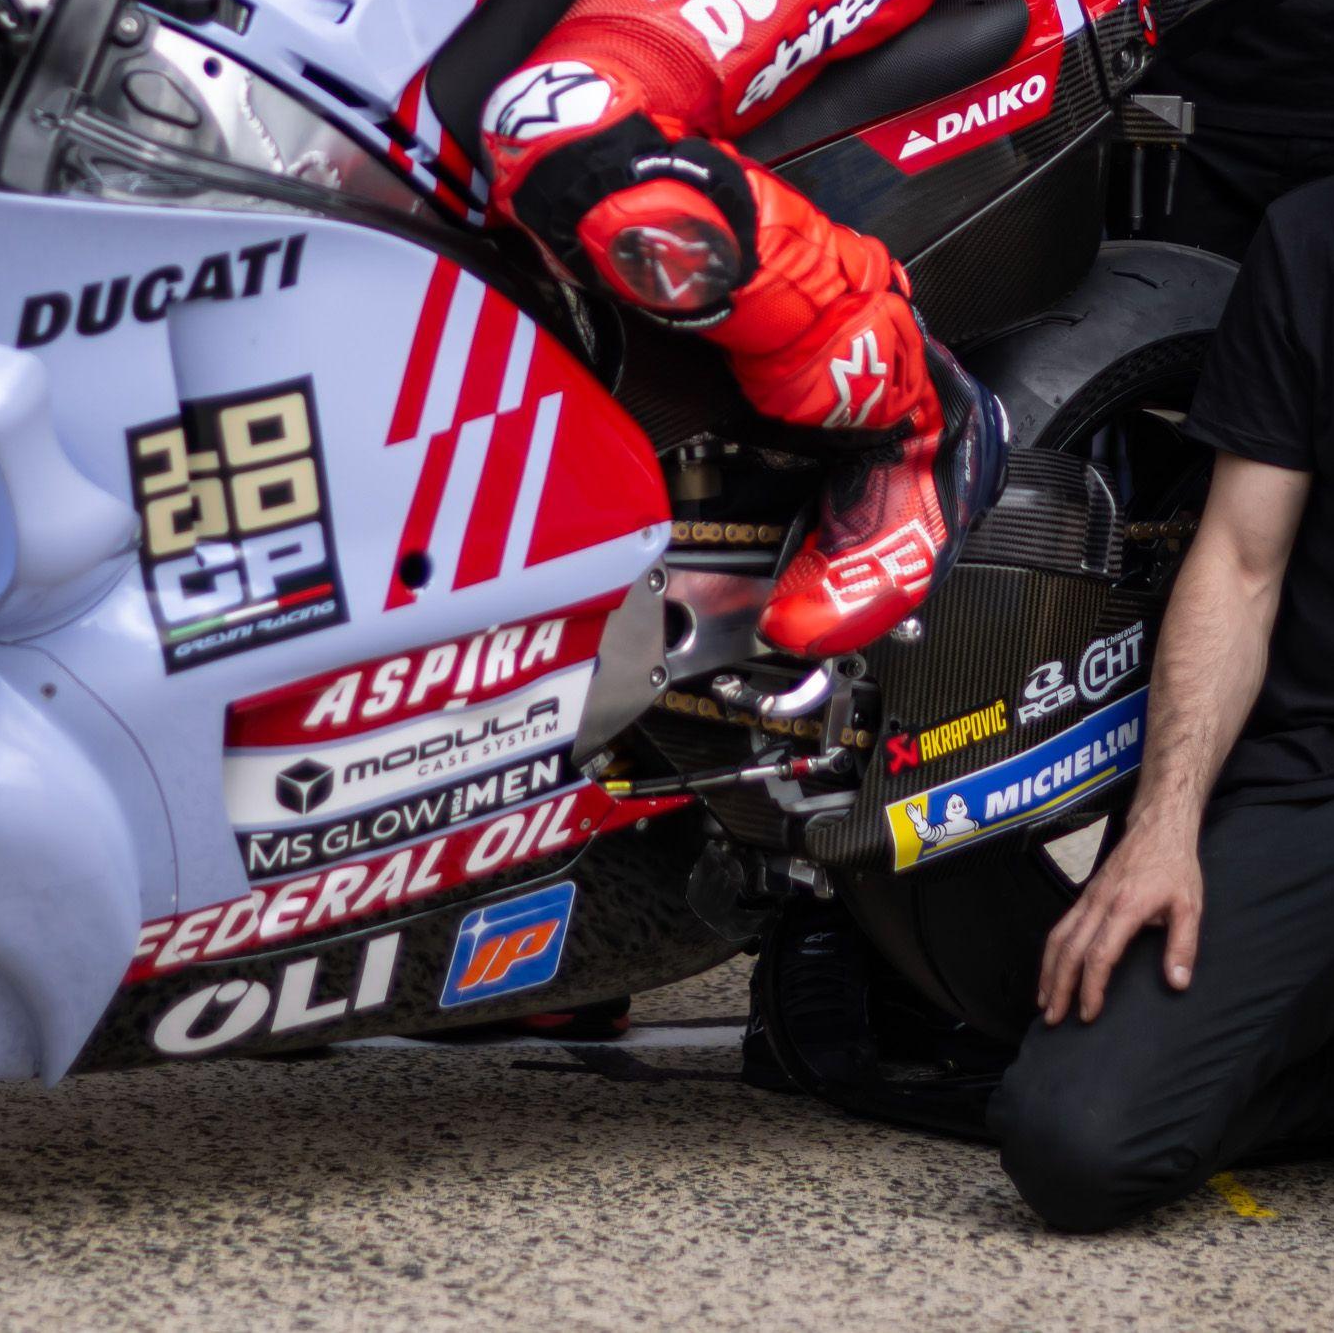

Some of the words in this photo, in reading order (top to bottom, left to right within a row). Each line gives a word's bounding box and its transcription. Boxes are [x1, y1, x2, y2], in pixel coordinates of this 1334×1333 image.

[936, 74, 1047, 143] DAIKO
[15, 232, 308, 349] DUCATI
[153, 521, 327, 624] GP
[173, 624, 254, 658] GRESINI
[255, 598, 337, 631] RACING
[1088, 630, 1144, 687] CHT
[1105, 619, 1143, 647] Chiaravalli
[301, 617, 567, 729] ASPIRA
[1017, 684, 1077, 725] RCB
[343, 695, 560, 784] MODULA
[417, 752, 470, 777] CASE
[482, 720, 559, 757] SYSTEM
[920, 699, 1007, 762] AKRAPOVIČ
[984, 717, 1139, 820] MICHELIN
[249, 832, 313, 872] MS
[322, 792, 447, 855] GLOW
[466, 753, 560, 811] MEN
[133, 837, 447, 968] FEDERAL
[465, 793, 578, 875] OIL
[153, 931, 401, 1054] OLI
[457, 919, 560, 992] IP
